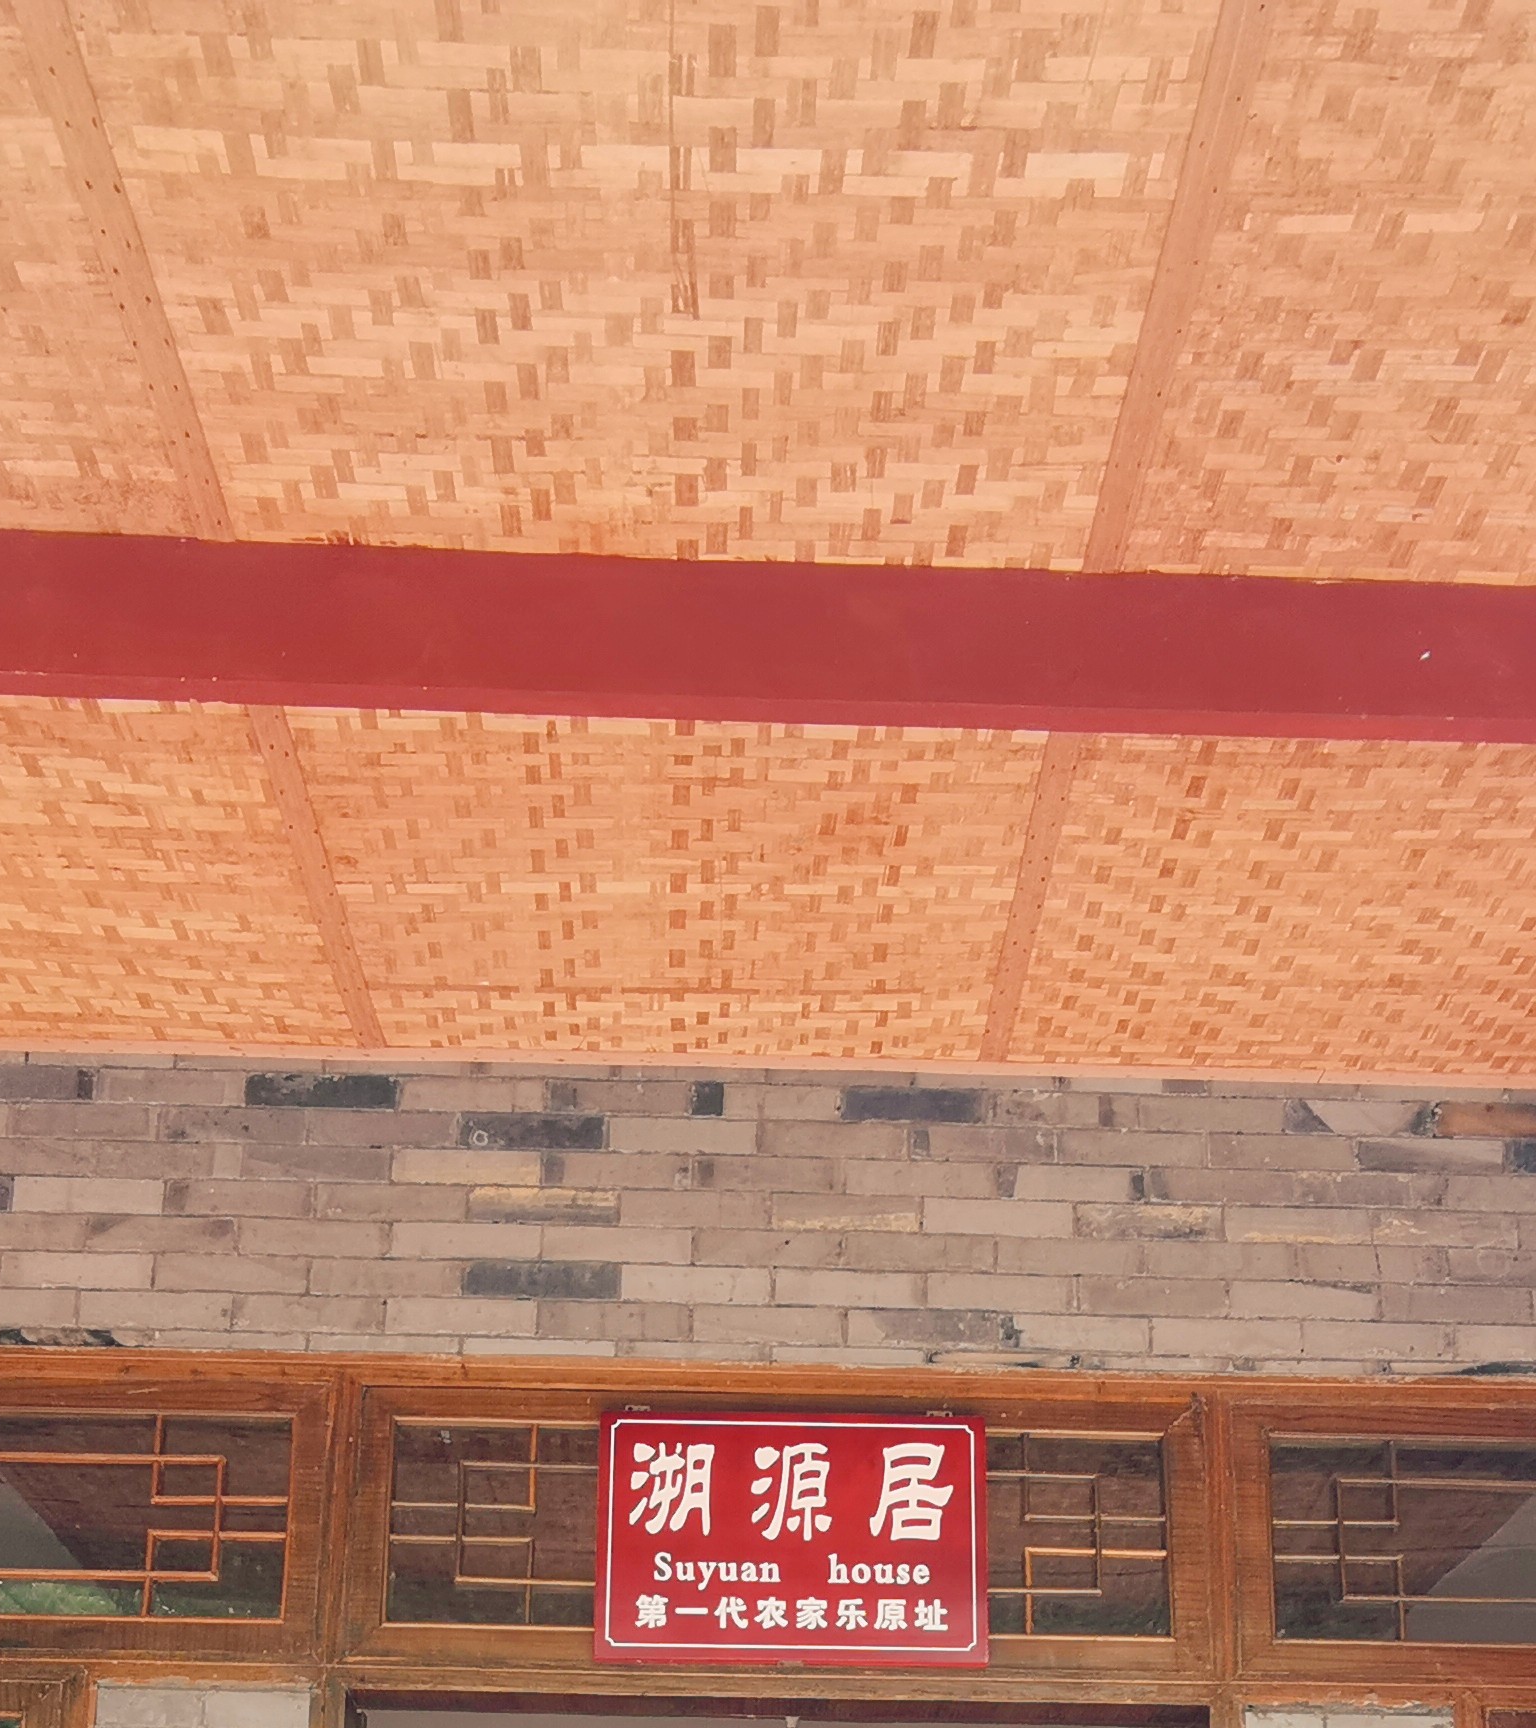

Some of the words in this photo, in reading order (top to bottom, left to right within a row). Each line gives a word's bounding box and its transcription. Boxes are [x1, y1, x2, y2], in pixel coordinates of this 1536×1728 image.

[628, 1441, 954, 1541] 溯源居
[652, 1552, 781, 1591] Suyuan
[827, 1553, 931, 1585] house
[634, 1593, 949, 1632] 第一代农家乐原址
